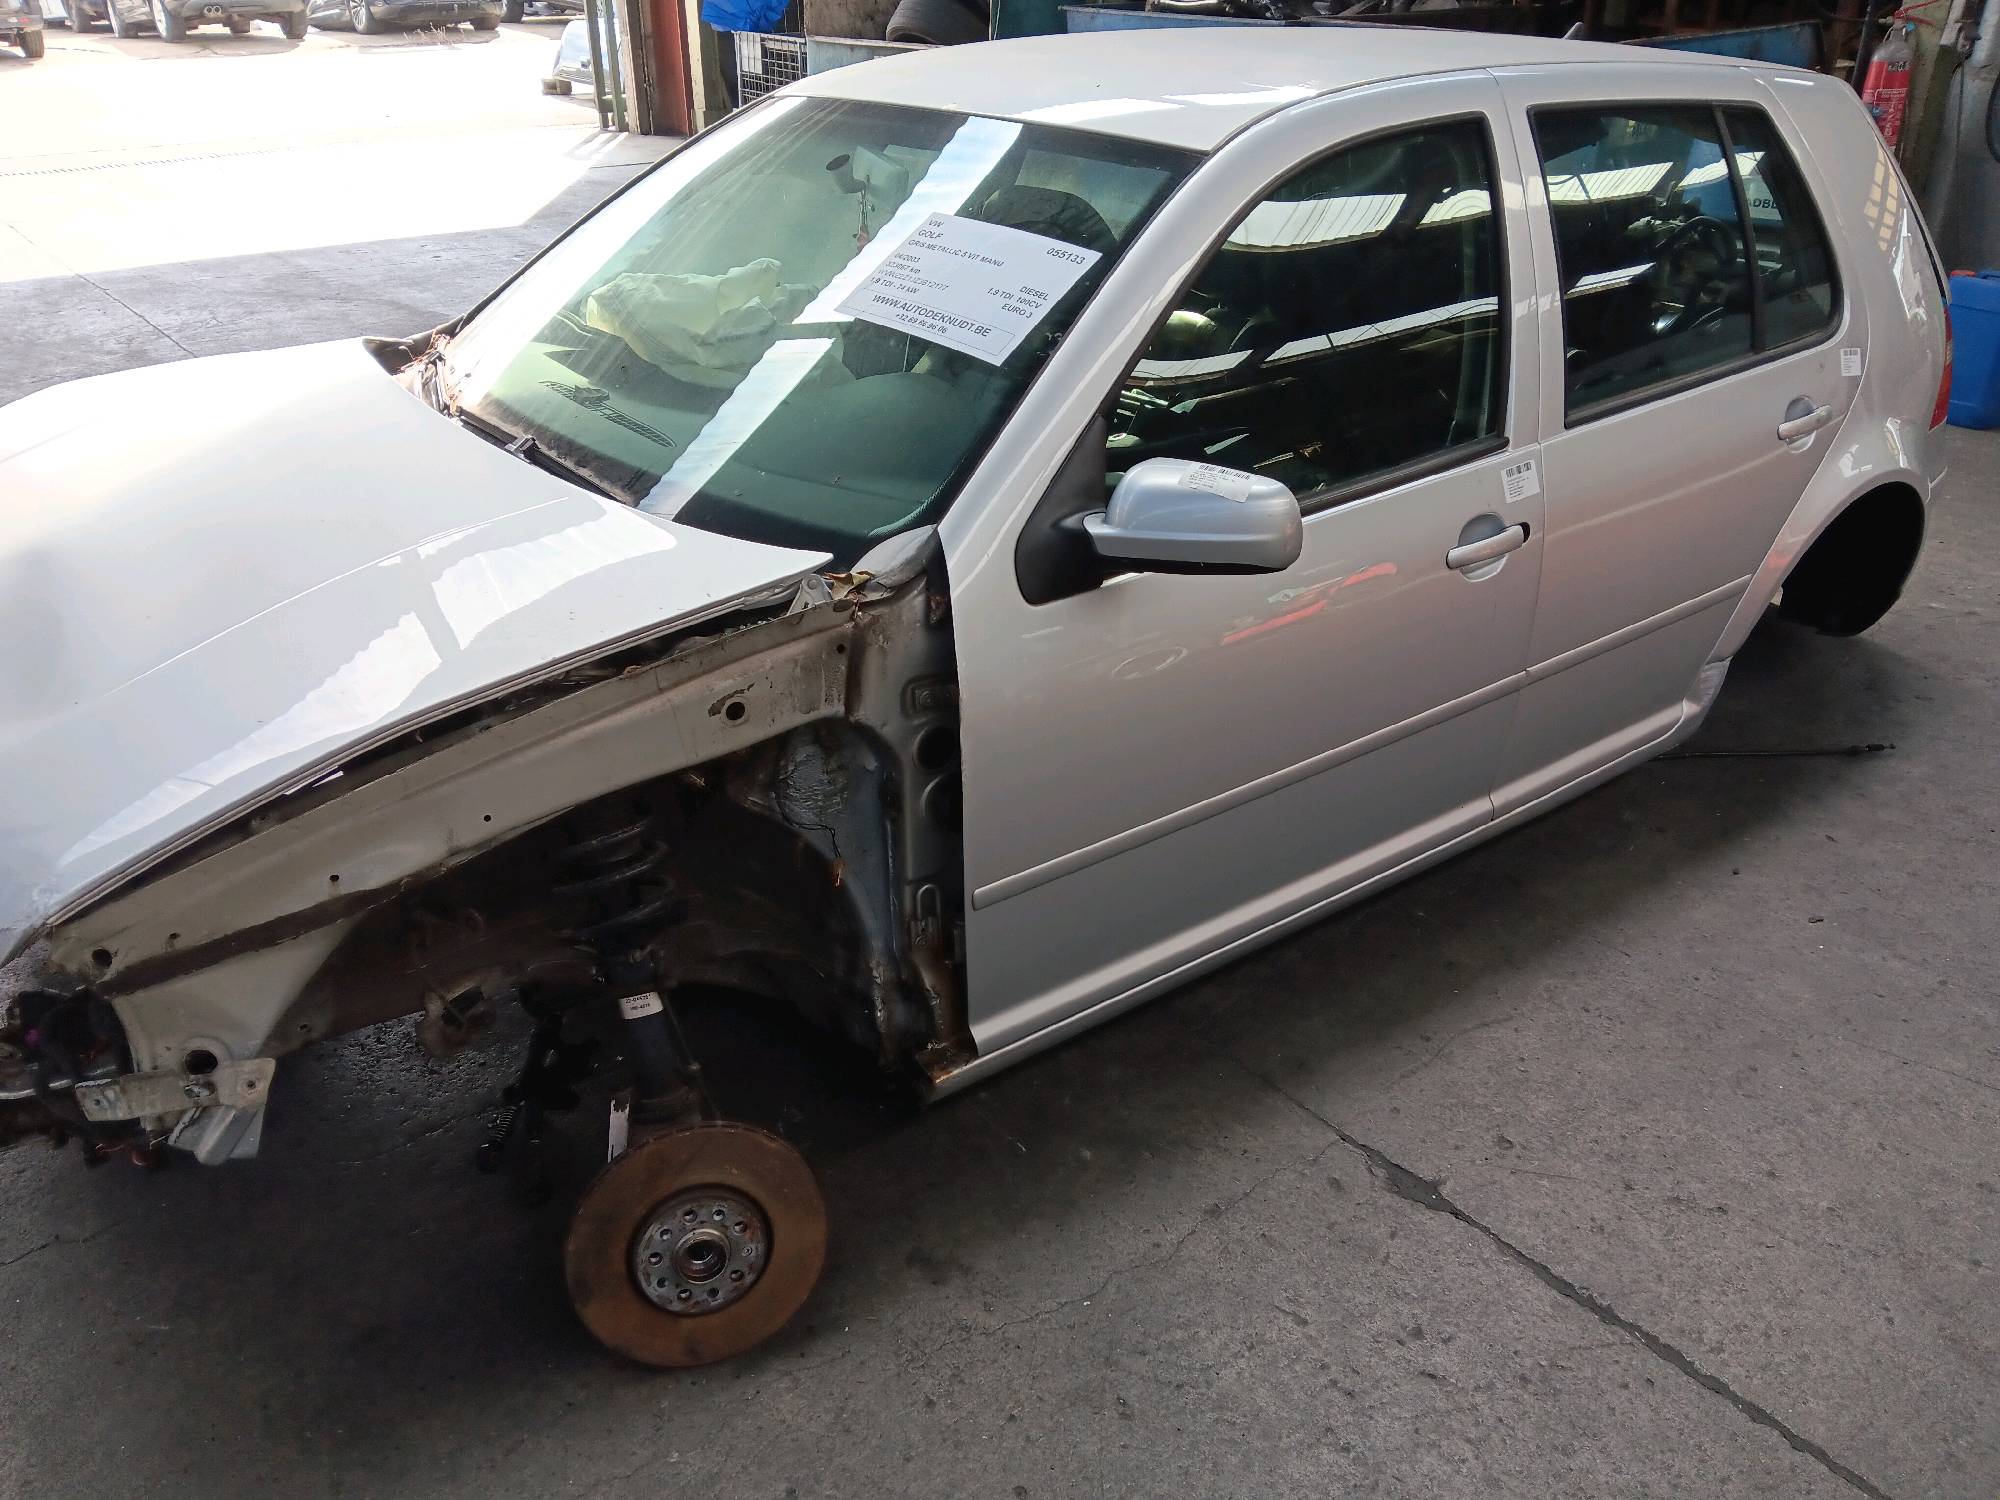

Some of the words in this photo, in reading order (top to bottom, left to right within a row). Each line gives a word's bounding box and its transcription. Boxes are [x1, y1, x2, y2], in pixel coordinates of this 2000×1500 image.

[928, 219, 944, 228] VW
[918, 229, 944, 240] GOLF
[908, 239, 927, 248] GRIS
[926, 243, 962, 256] METALLIC
[968, 252, 981, 261] VIT
[979, 256, 1005, 267] MANU
[1046, 247, 1086, 265] 055133
[871, 277, 881, 285] 1.9
[880, 279, 894, 288] TDI
[987, 287, 1000, 296] 1.9
[999, 291, 1014, 300] TDI
[1019, 286, 1049, 301] DIESEL
[872, 294, 992, 337] WWW.AUTODEKNUDT.BE
[1001, 303, 1026, 316] EURO
[1025, 311, 1033, 319] 3
